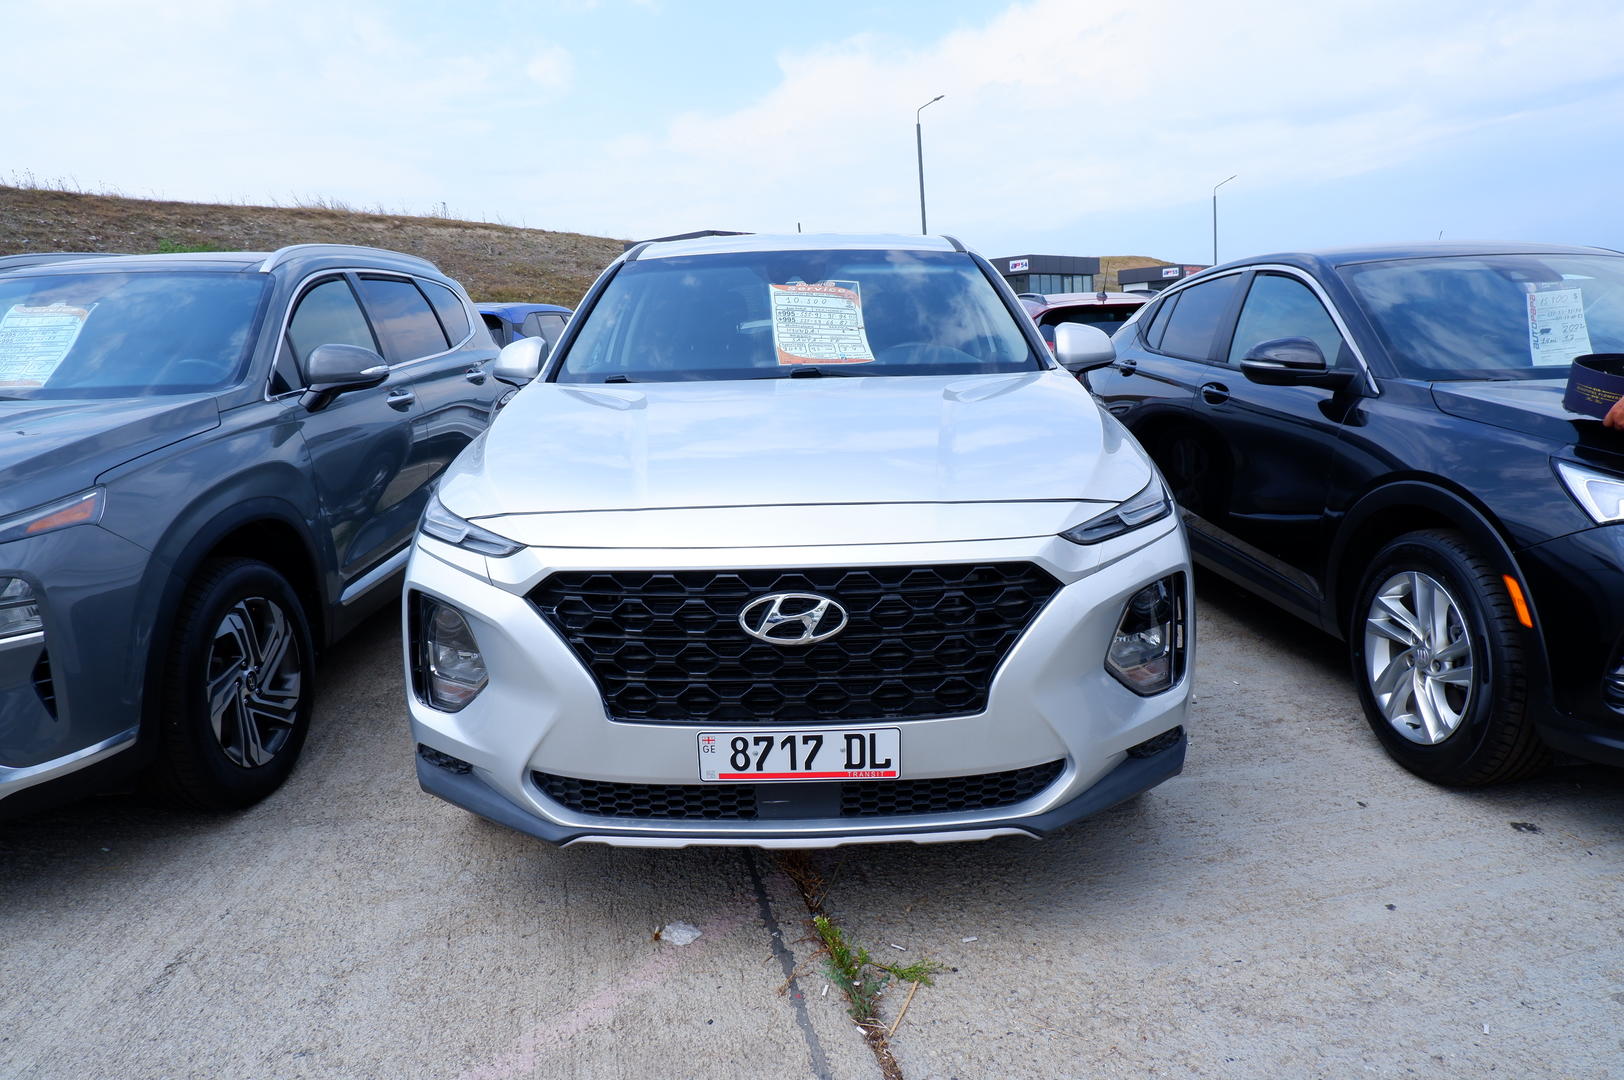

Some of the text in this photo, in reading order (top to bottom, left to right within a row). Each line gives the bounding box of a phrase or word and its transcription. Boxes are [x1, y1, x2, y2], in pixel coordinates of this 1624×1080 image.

[702, 745, 716, 753] GE
[730, 733, 891, 771] 8717 DL
